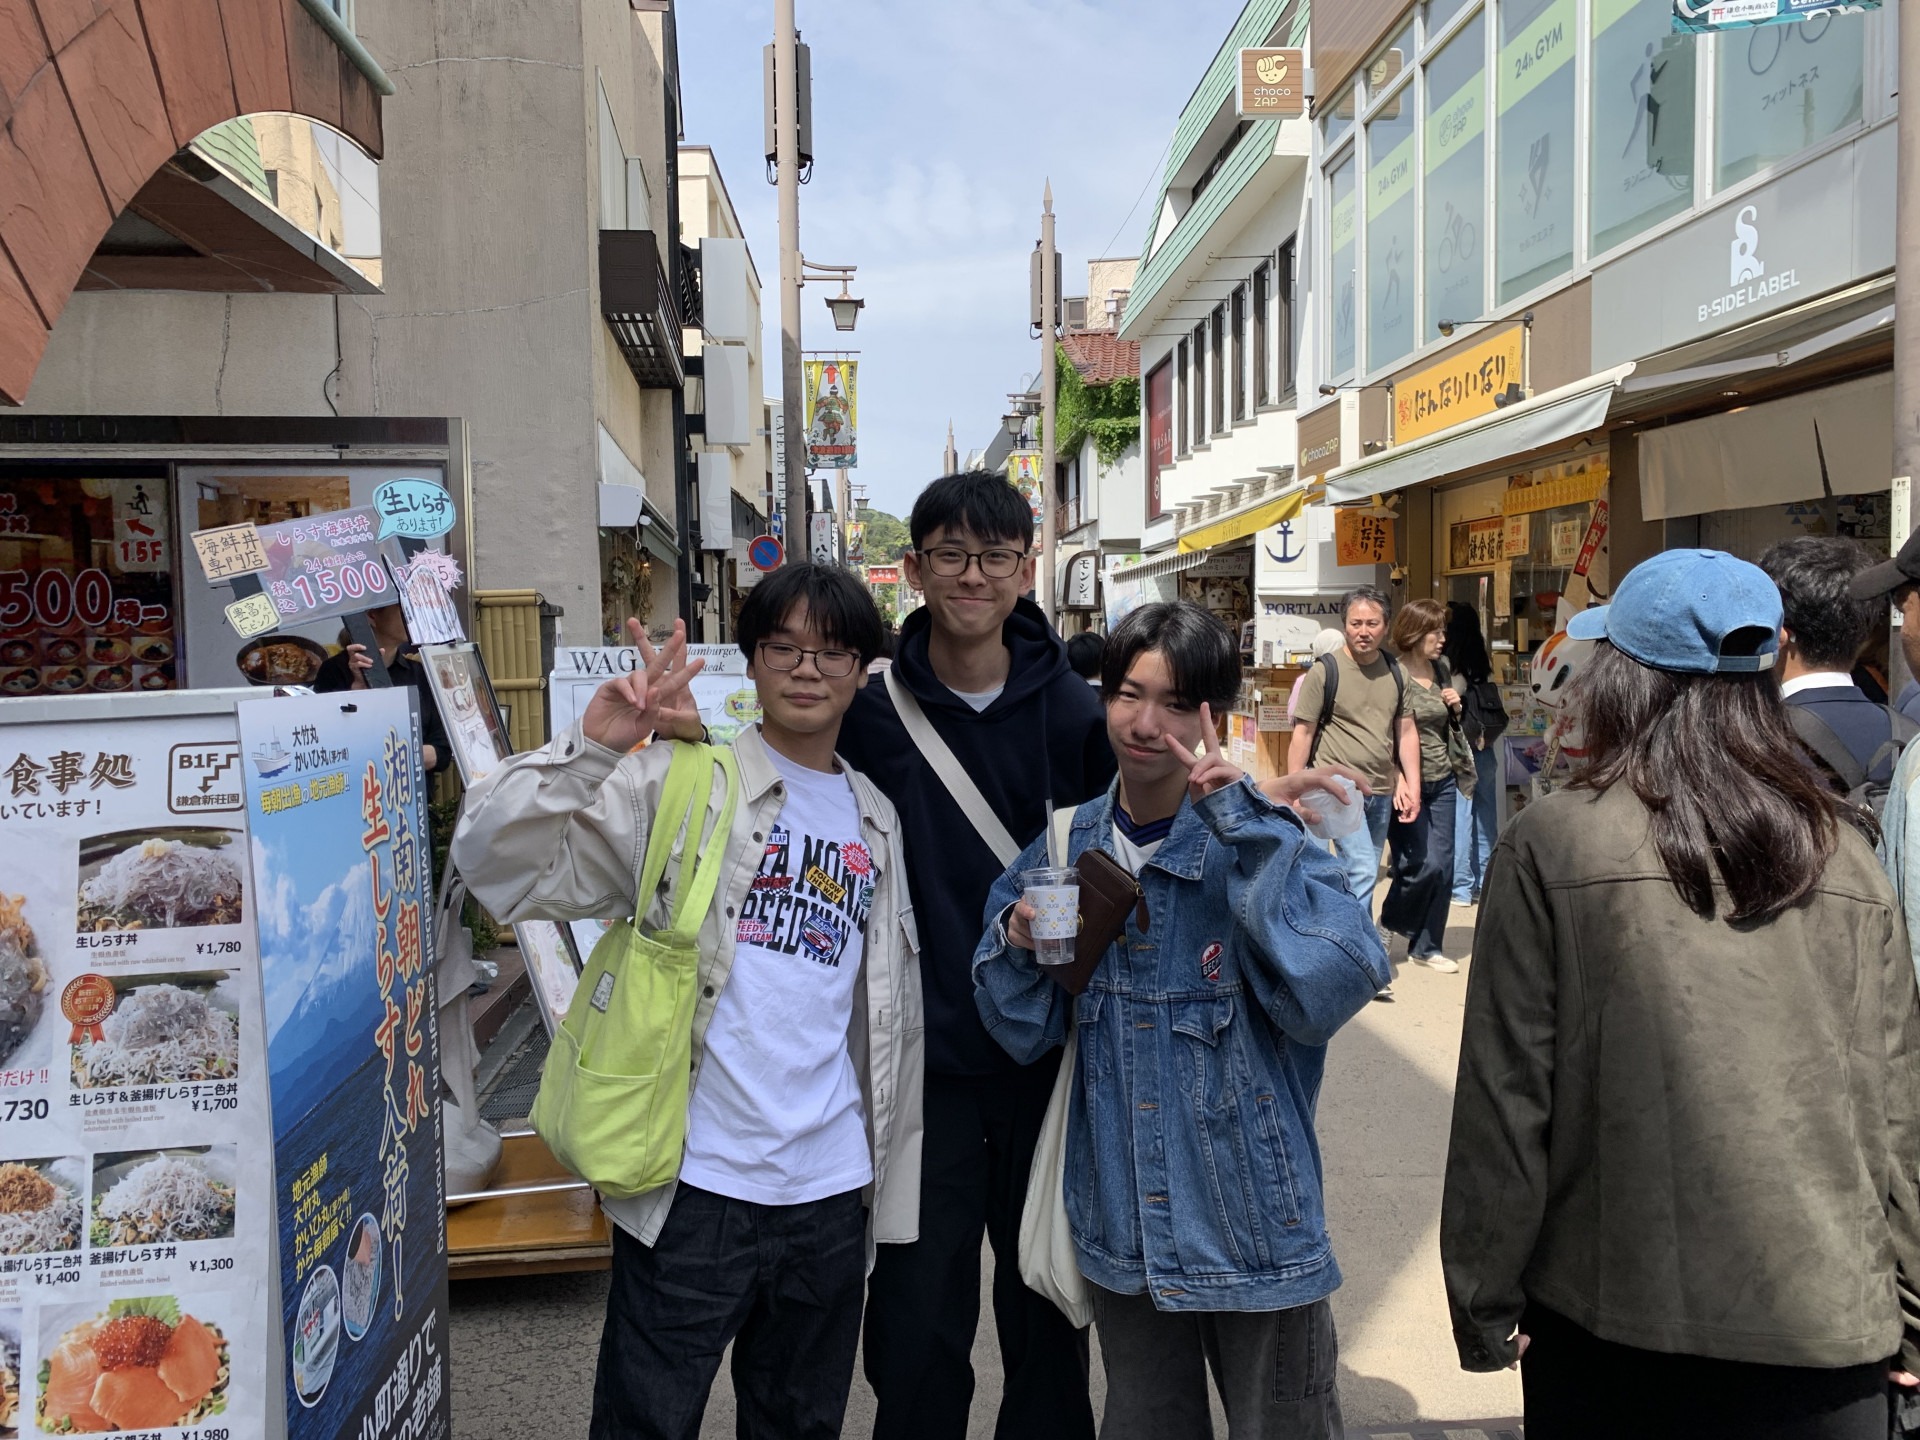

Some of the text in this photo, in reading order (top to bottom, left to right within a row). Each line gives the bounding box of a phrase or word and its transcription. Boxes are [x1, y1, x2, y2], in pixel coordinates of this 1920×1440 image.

[1535, 22, 1564, 62] GYM
[1253, 86, 1291, 96] choco
[1254, 97, 1278, 107] ZAP
[1761, 65, 1820, 112] フィットネス
[1390, 158, 1408, 186] GYM
[1697, 268, 1801, 323] B-SIDE LABEL
[1414, 354, 1506, 423] はんなりいなり
[381, 486, 450, 516] 生しらす
[199, 530, 259, 556] 海鮮丼
[276, 515, 370, 547] しらす海鮮丼
[120, 540, 162, 563] 1.5F
[208, 550, 263, 576] 専門店
[292, 560, 387, 608] 1500
[1079, 559, 1090, 599] モンシェ
[292, 724, 319, 747] 大竹丸
[410, 711, 423, 783] Fresh
[3, 751, 137, 797] 食事処
[179, 754, 218, 769] B1F
[176, 793, 240, 807] 鎌倉新荘園
[416, 791, 427, 839] raw
[808, 875, 822, 888] THE
[823, 885, 839, 901] WAY
[813, 870, 843, 894] FOLLOW
[420, 847, 435, 967] whitebait
[76, 934, 242, 955] 生しらす丼 ¥1,780
[428, 972, 440, 1062] caught
[191, 1097, 238, 1113] ¥1,700
[433, 1096, 442, 1141] the
[294, 1189, 321, 1231] 大竹丸
[434, 1147, 445, 1255] morning
[0, 1254, 82, 1286] 揚げしらす二色丼 ¥1,400
[89, 1246, 234, 1272] 釜揚げしらす丼 ¥1,300
